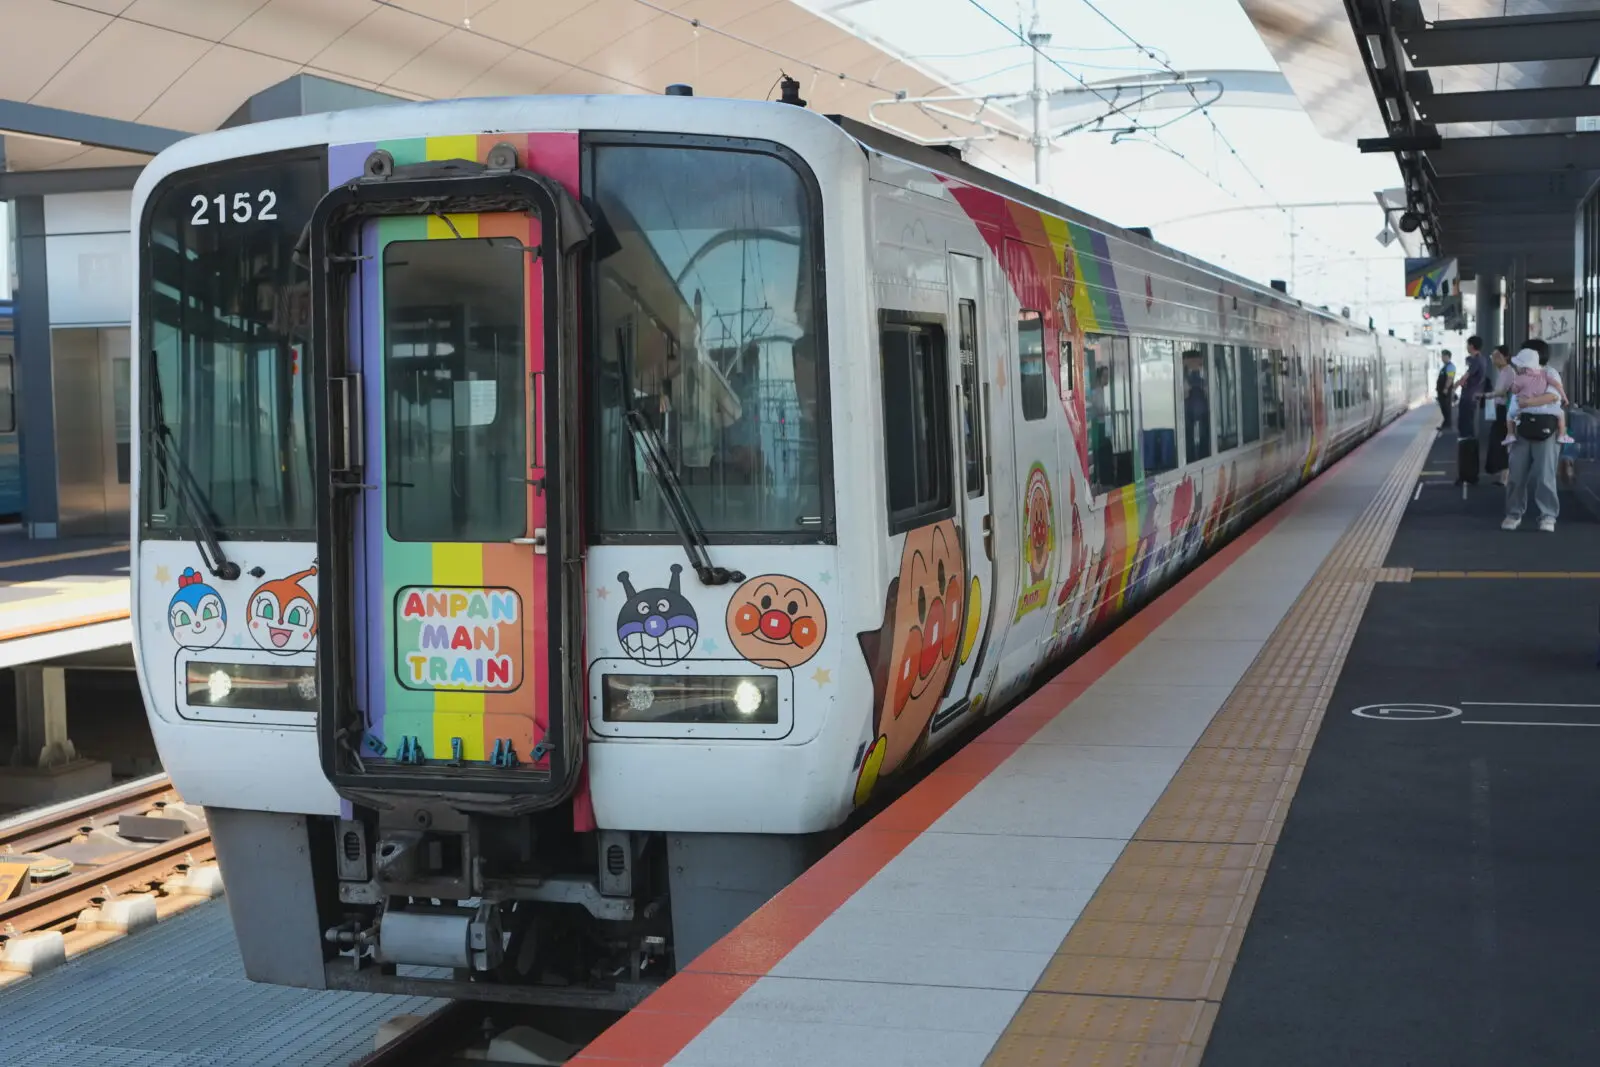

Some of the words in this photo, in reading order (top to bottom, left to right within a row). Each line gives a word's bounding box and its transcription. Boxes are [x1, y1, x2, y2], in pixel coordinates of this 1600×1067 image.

[190, 189, 278, 226] 2152
[404, 592, 514, 621] ANPAN
[422, 624, 496, 651] MAN
[409, 655, 509, 684] TRAIN
